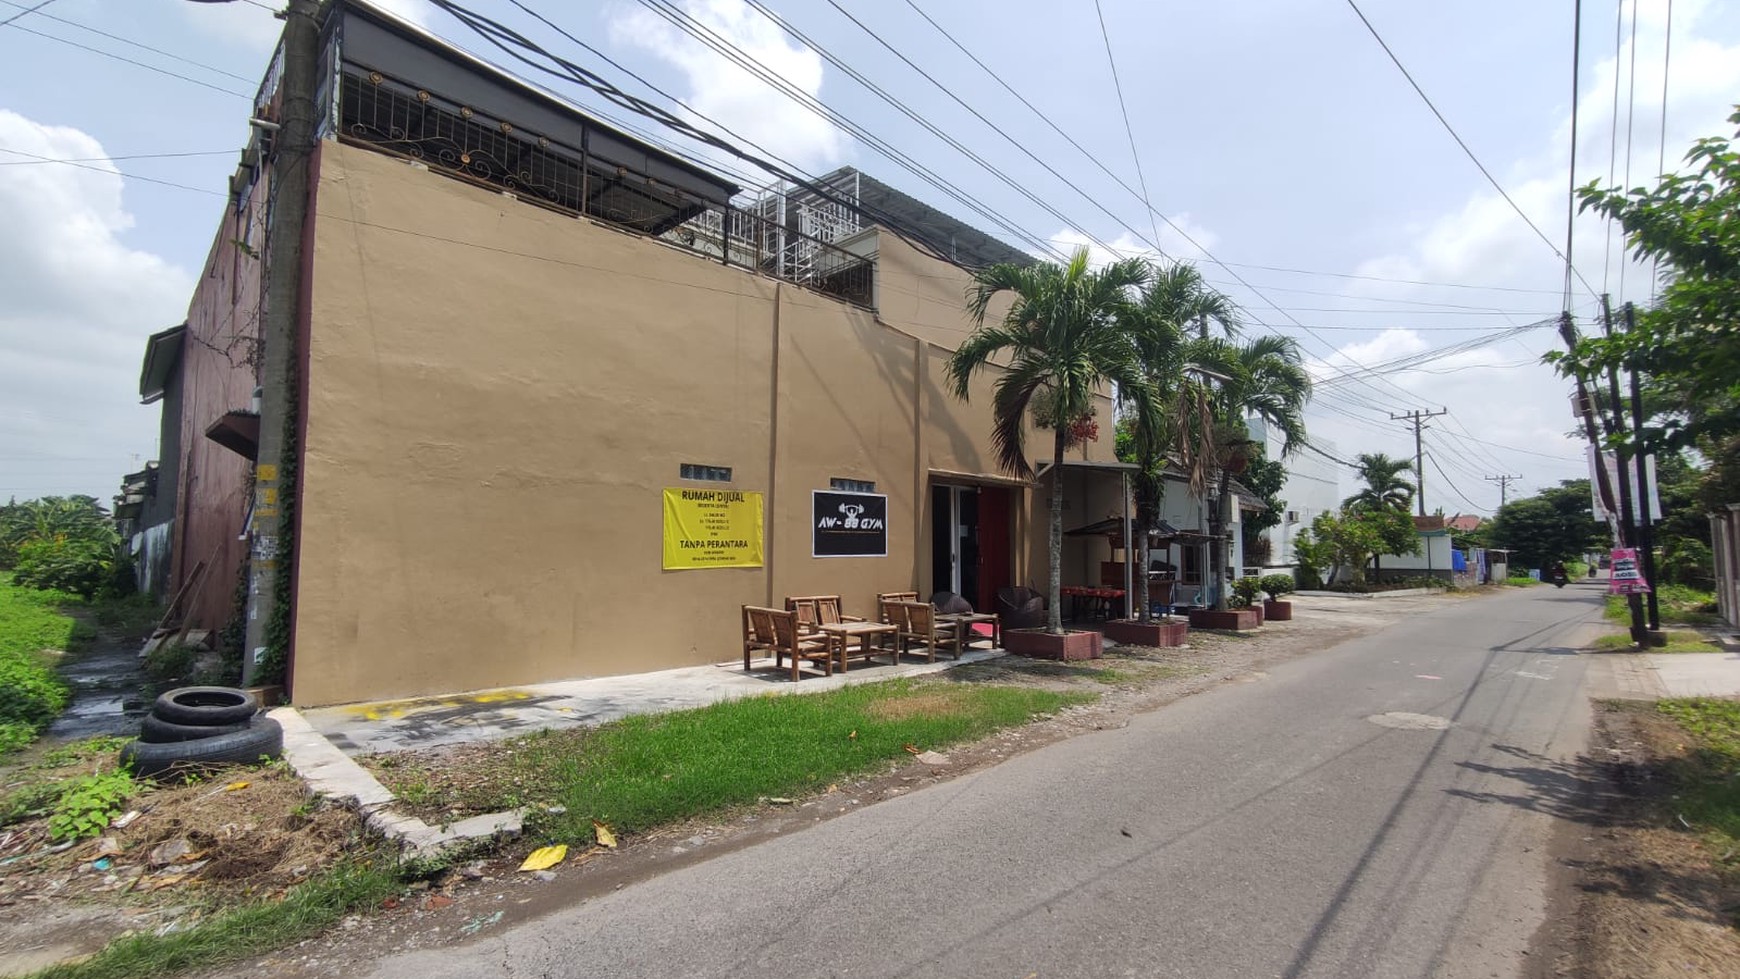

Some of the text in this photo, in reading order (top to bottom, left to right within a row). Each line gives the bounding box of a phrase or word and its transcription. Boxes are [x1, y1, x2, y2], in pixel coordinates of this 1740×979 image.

[682, 490, 745, 504] RUMAH DIJUAL
[860, 518, 884, 530] GYM
[680, 540, 748, 549] TANPA PERANTARA
